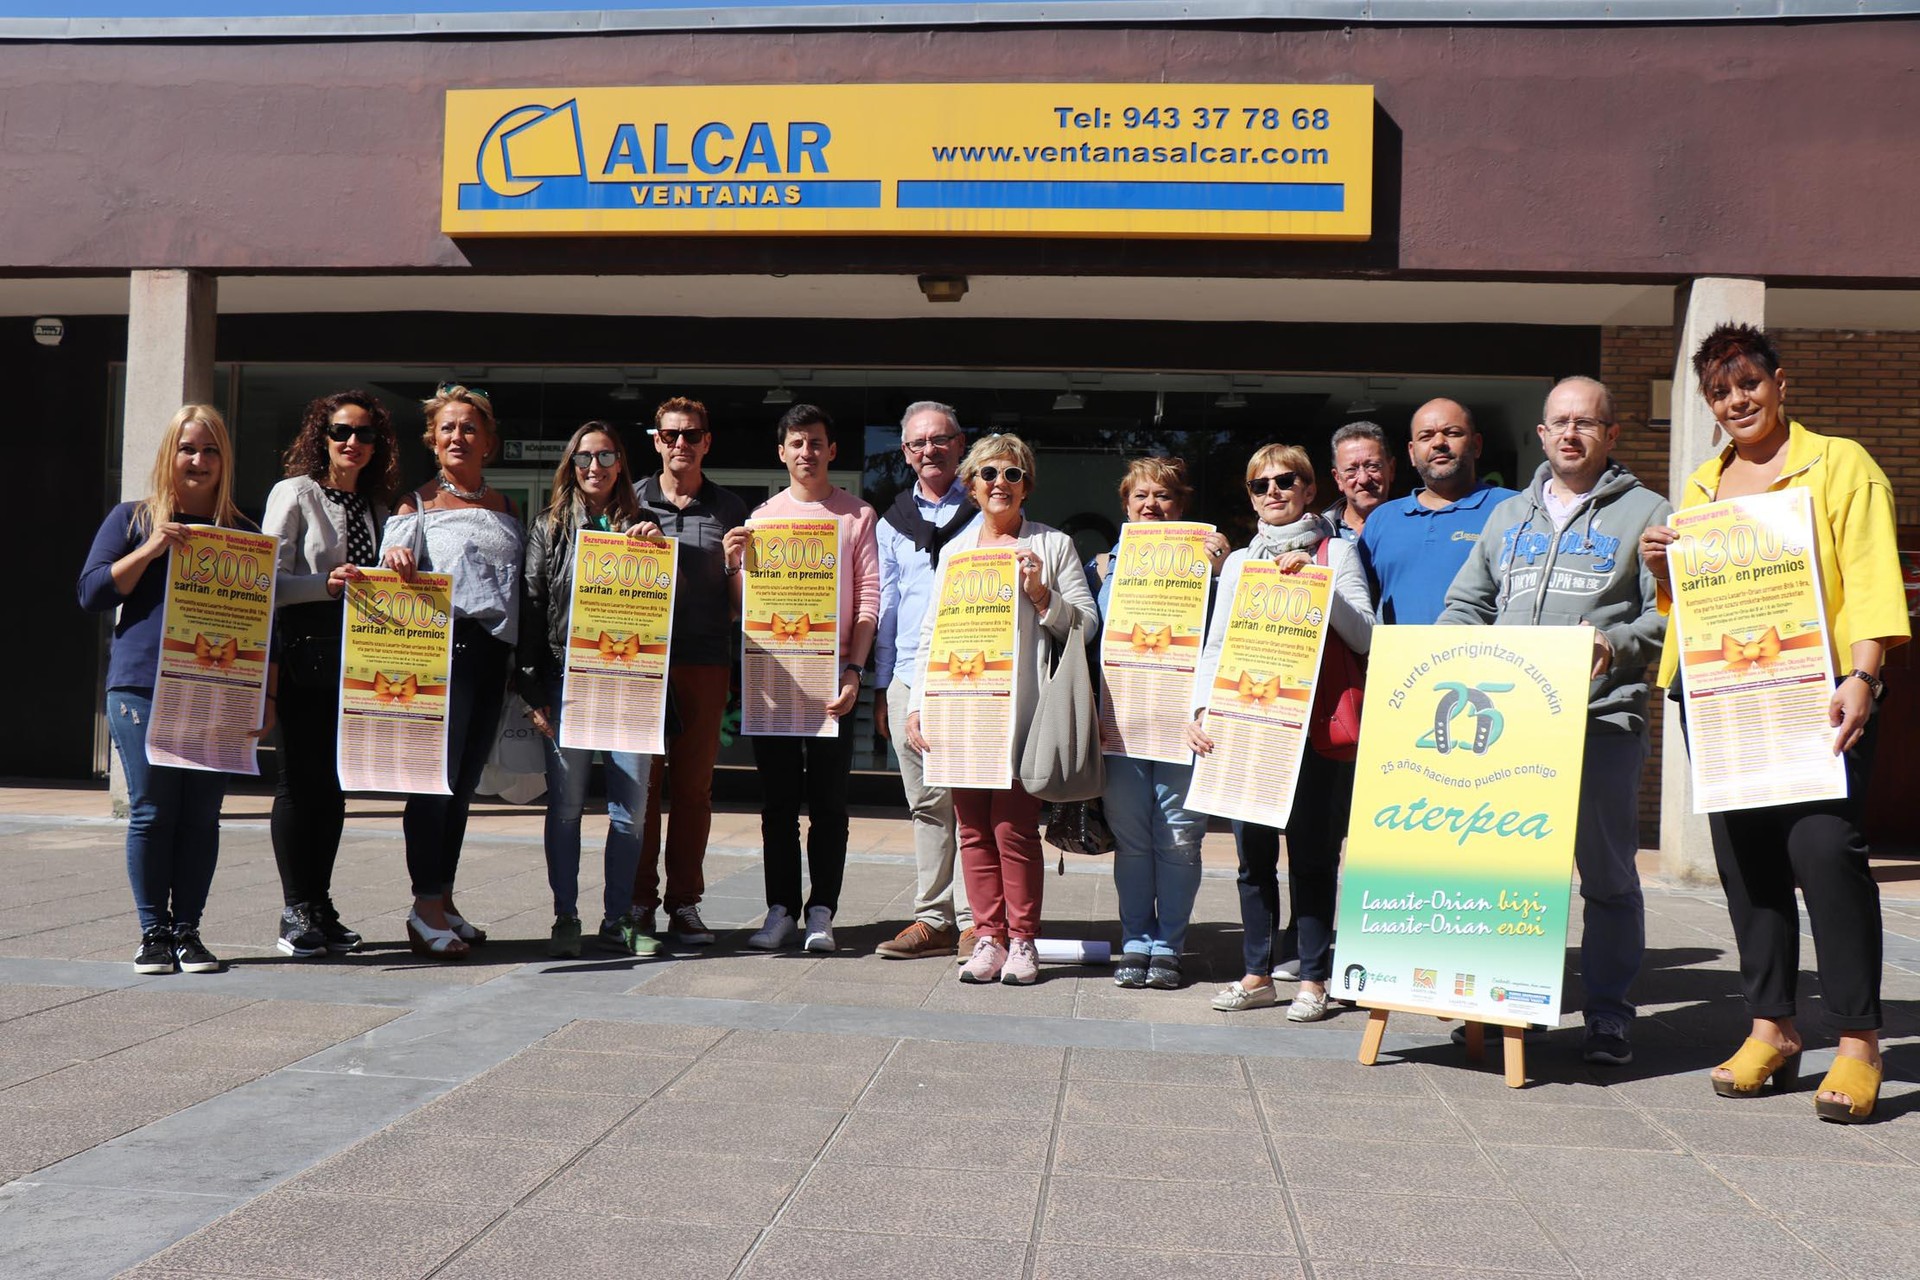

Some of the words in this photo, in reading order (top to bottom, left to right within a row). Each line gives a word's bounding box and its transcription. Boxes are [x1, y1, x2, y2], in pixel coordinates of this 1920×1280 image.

[1054, 107, 1111, 129] Tel:
[1123, 108, 1181, 129] 943
[1193, 108, 1229, 130] 37
[1243, 108, 1280, 131] 78
[1293, 108, 1330, 131] 68
[602, 122, 831, 175] ALCAR
[932, 141, 1329, 165] www.ventanasalcar.com
[630, 184, 801, 205] VENTANAS
[750, 569, 780, 578] saritan
[800, 571, 833, 580] premios
[1118, 578, 1147, 586] saritan
[1154, 578, 1163, 586] en
[1166, 578, 1202, 589] premios
[1681, 574, 1726, 592] saritan
[1736, 569, 1750, 582] en
[1753, 559, 1805, 582] premios
[174, 581, 210, 594] saritan
[217, 588, 228, 597] en
[230, 589, 267, 603] premios
[579, 585, 612, 595] saritan
[632, 590, 667, 600] premios
[965, 606, 974, 614] en
[976, 604, 1010, 615] premios
[351, 624, 386, 634] saritan
[394, 627, 405, 636] en
[407, 629, 445, 639] premios
[1231, 619, 1258, 631] saritan
[1266, 623, 1276, 633] en
[1278, 625, 1317, 639] premios
[1388, 689, 1406, 710] 25
[1403, 661, 1430, 689] urte
[1431, 641, 1524, 669] herrigintzan
[1525, 663, 1562, 716] zurekin
[1380, 760, 1395, 775] 25
[1397, 758, 1421, 773] años
[1423, 766, 1472, 788] haciendo
[1475, 767, 1512, 789] pueblo
[1514, 763, 1557, 778] contigo
[1373, 797, 1554, 846] aterpea
[1362, 890, 1493, 911] Lasarte-Orian
[1497, 889, 1547, 918] bizi,
[1361, 914, 1491, 935] Lasarte-Orian
[1497, 916, 1544, 937] erosi
